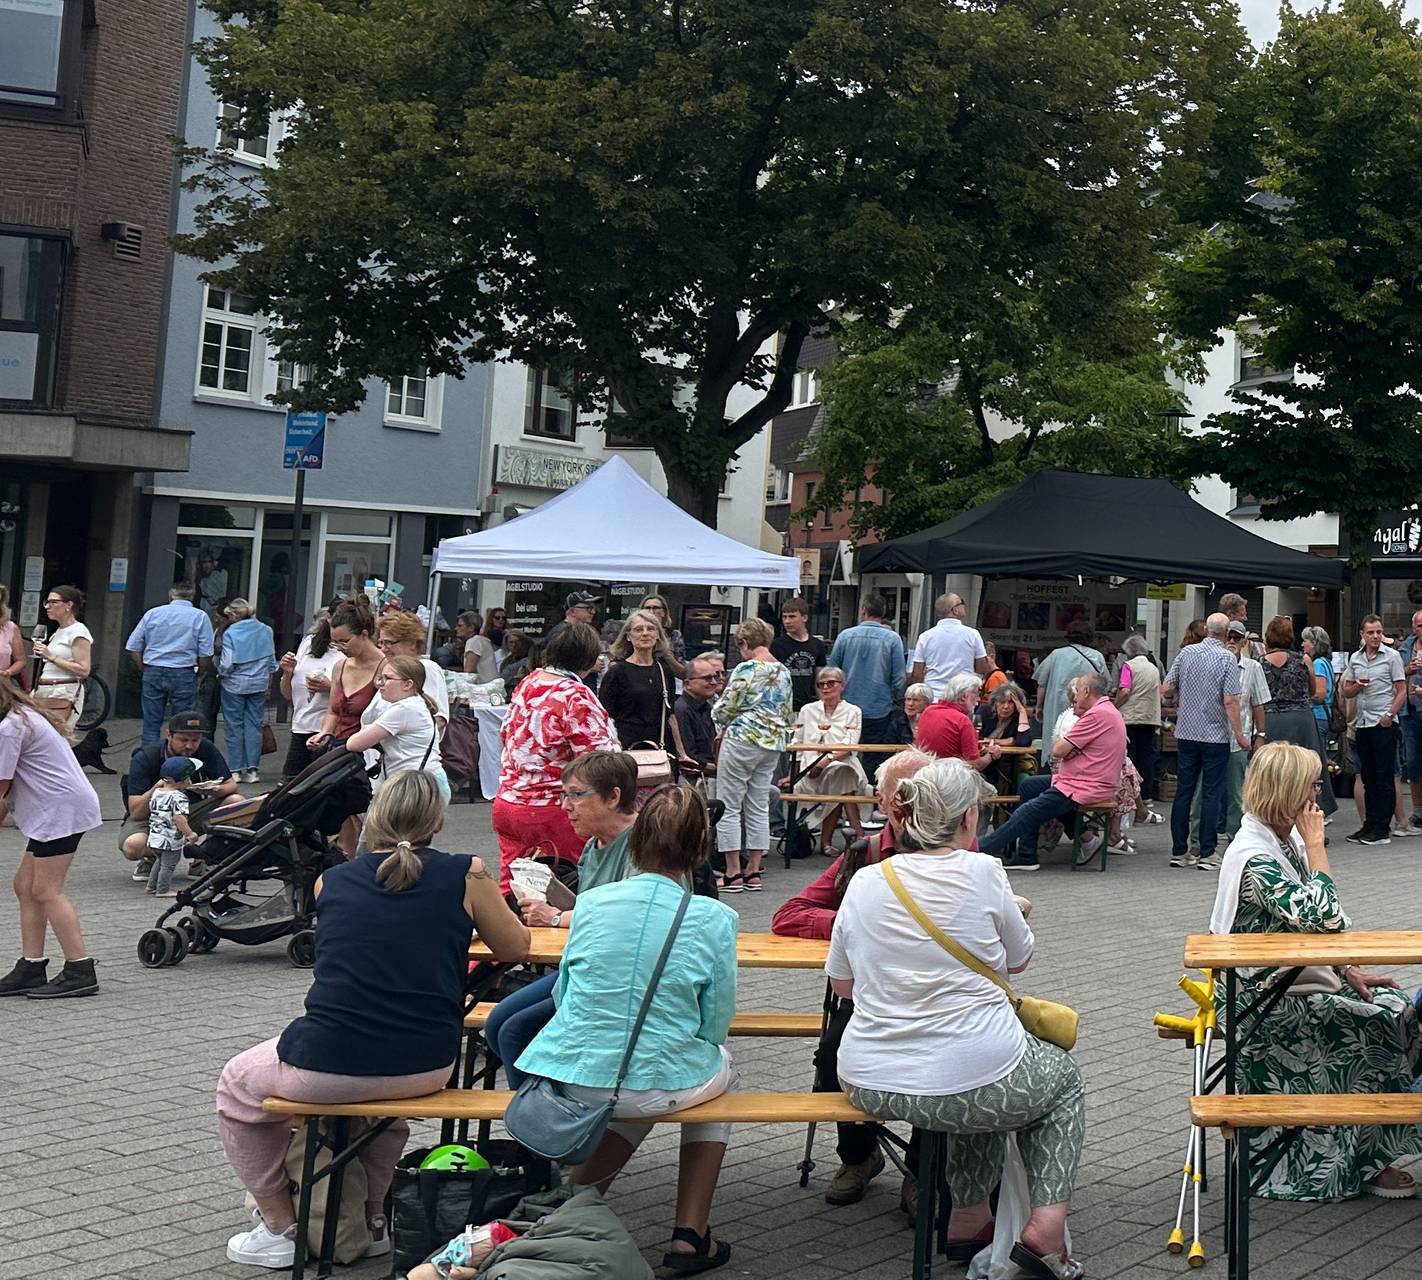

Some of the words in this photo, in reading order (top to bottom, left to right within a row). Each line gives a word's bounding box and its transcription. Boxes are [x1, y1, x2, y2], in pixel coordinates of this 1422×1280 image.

[303, 454, 319, 463] AfD
[1373, 520, 1407, 554] ngal
[506, 582, 544, 592] AGELSTUDIO
[1026, 584, 1070, 594] HOFFEST
